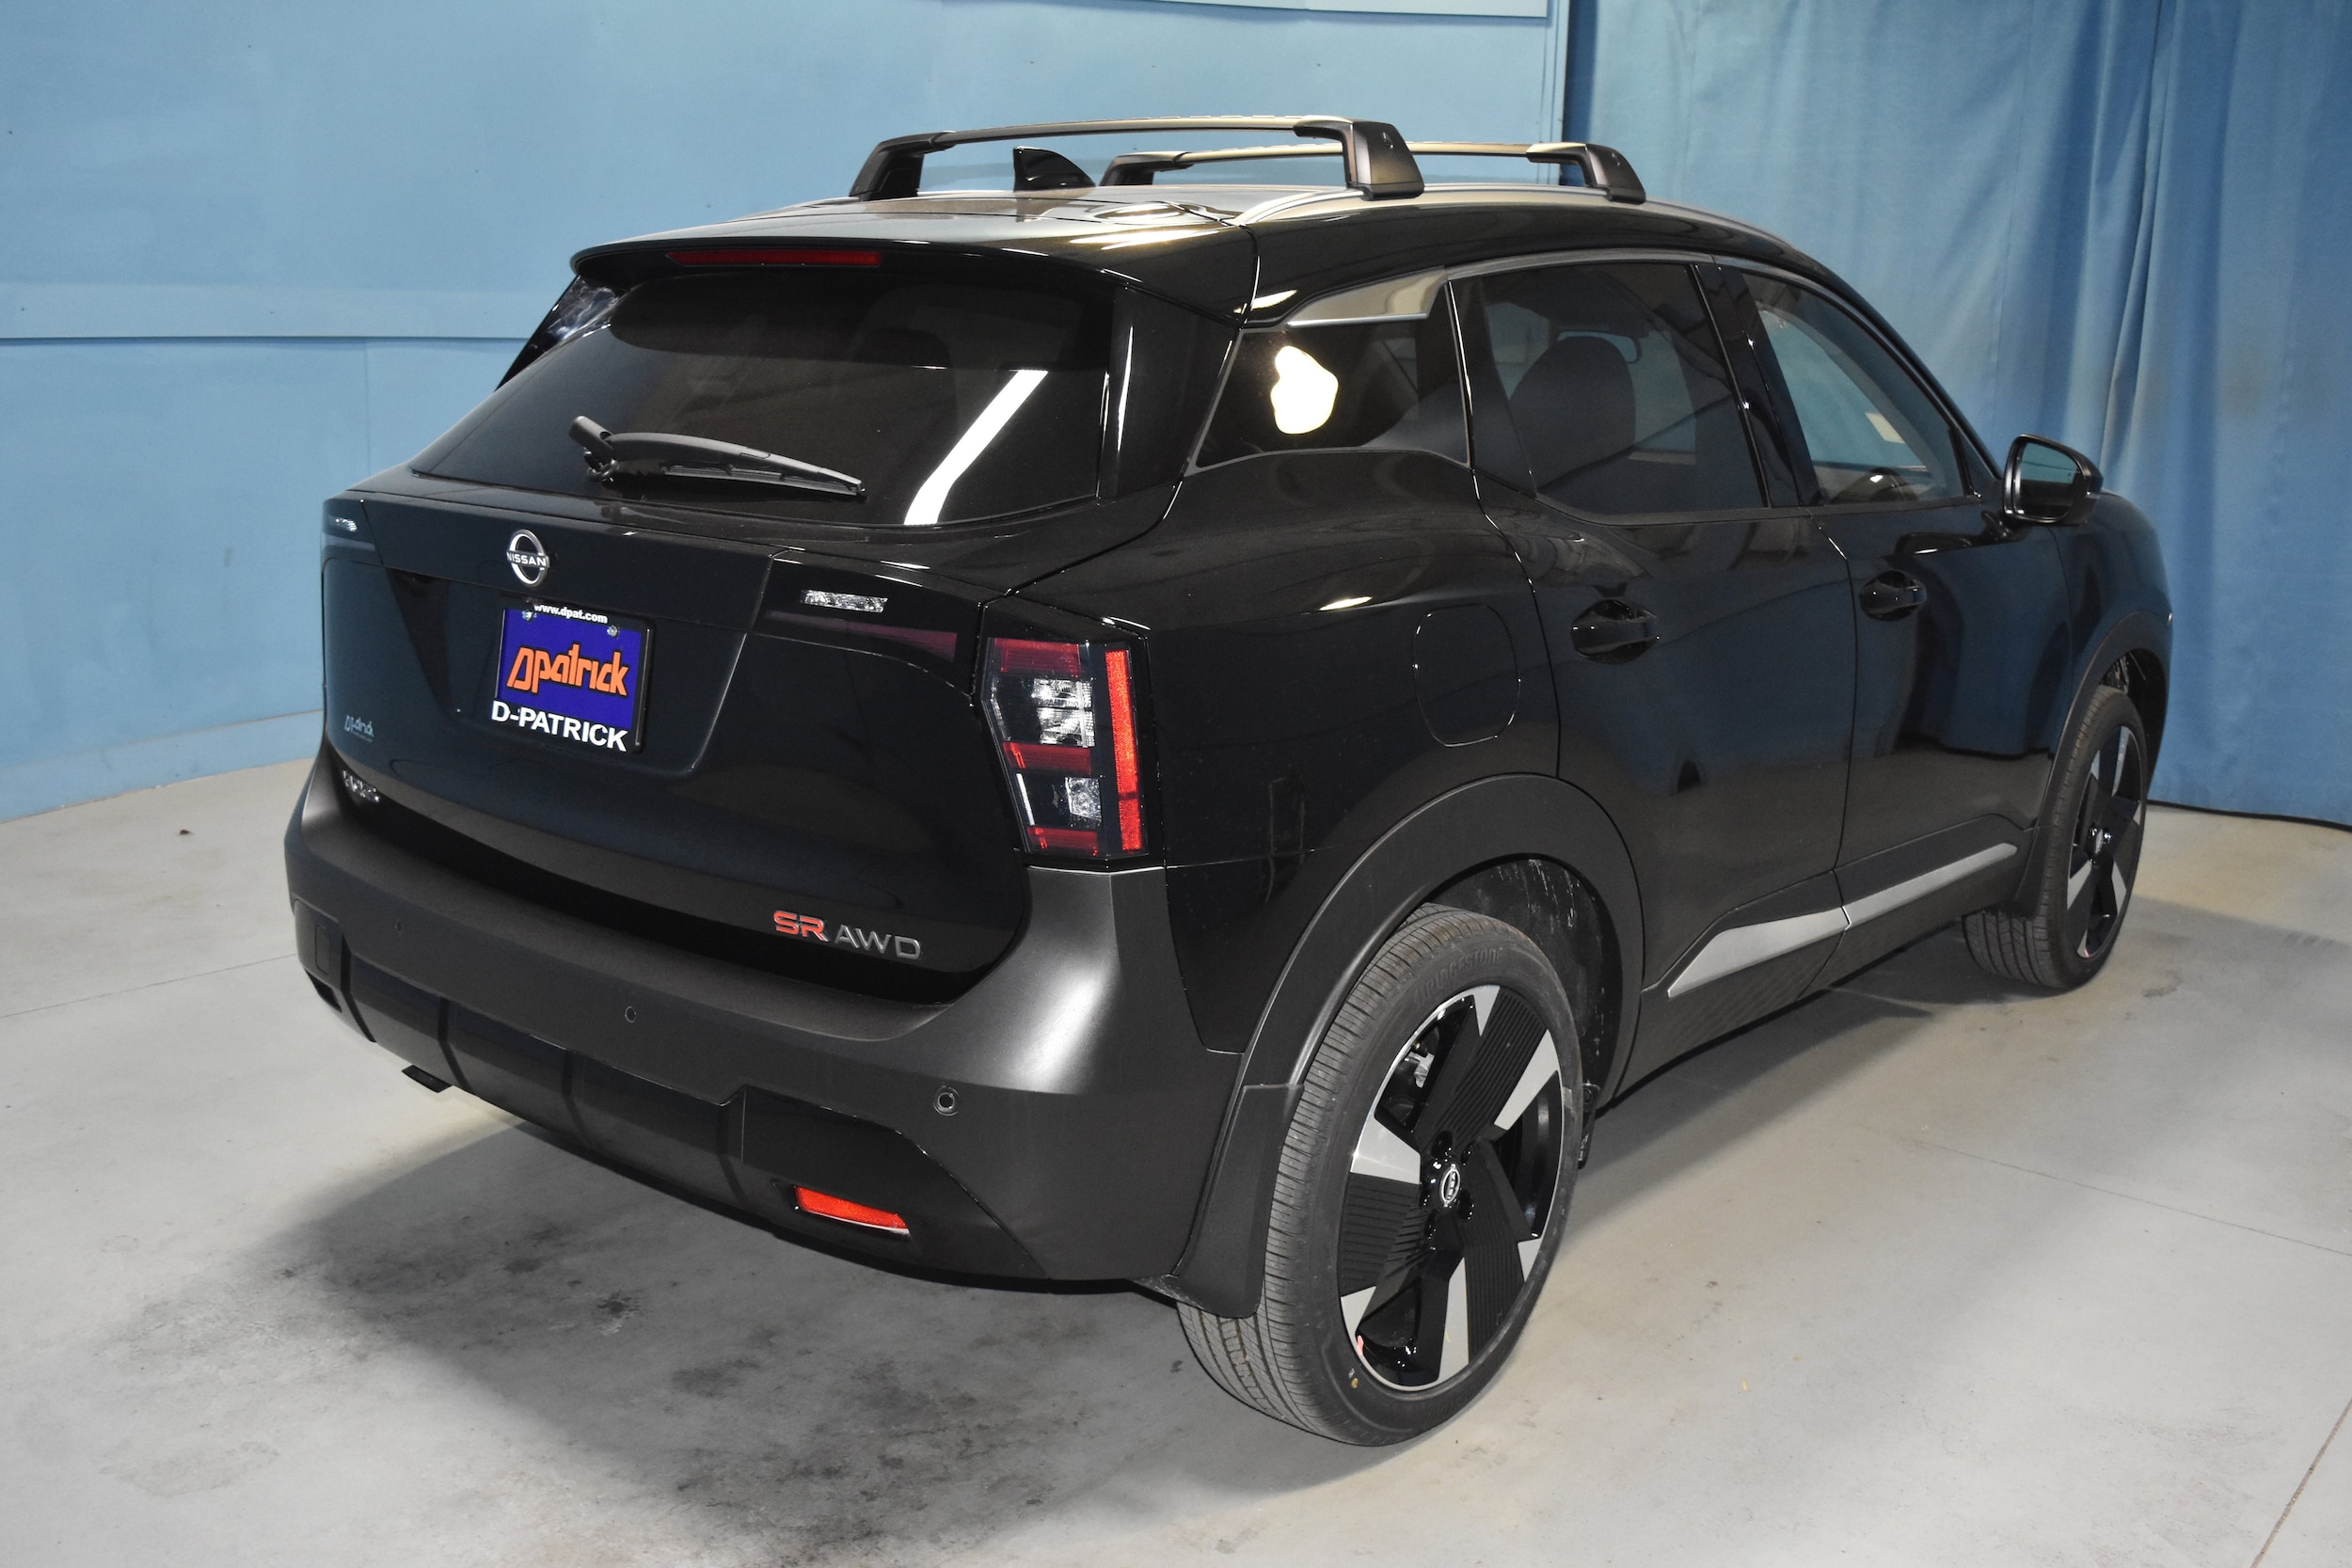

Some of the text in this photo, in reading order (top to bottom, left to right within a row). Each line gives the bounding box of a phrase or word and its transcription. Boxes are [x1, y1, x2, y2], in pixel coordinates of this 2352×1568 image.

[506, 552, 547, 566] NISSAN
[533, 604, 608, 624] www.dpat.com
[491, 701, 628, 752] D-PATRICK
[773, 911, 921, 960] SR AWD
